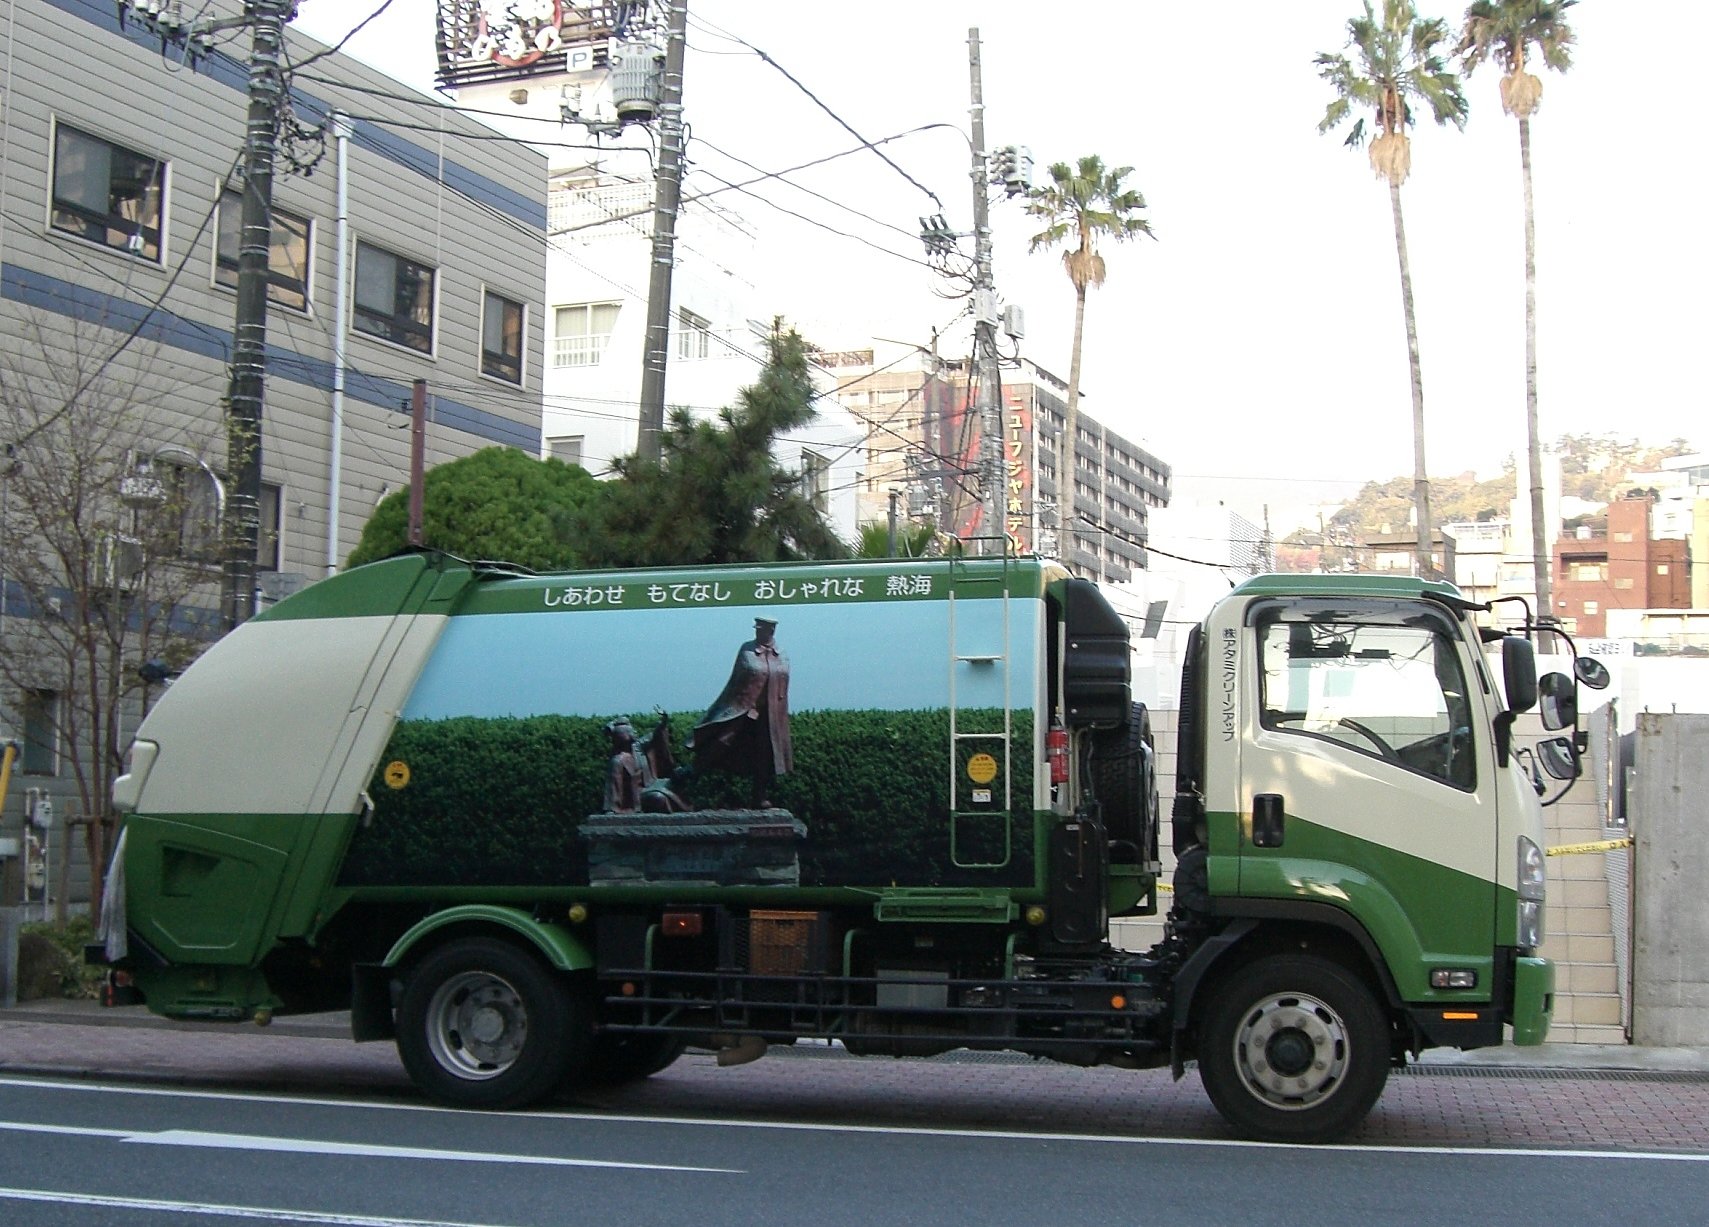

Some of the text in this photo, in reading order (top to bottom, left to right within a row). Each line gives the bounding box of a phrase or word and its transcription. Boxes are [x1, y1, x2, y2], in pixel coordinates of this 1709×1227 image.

[572, 52, 588, 68] P
[543, 575, 932, 607] しあわせ もてなし おしゃれな 熱海
